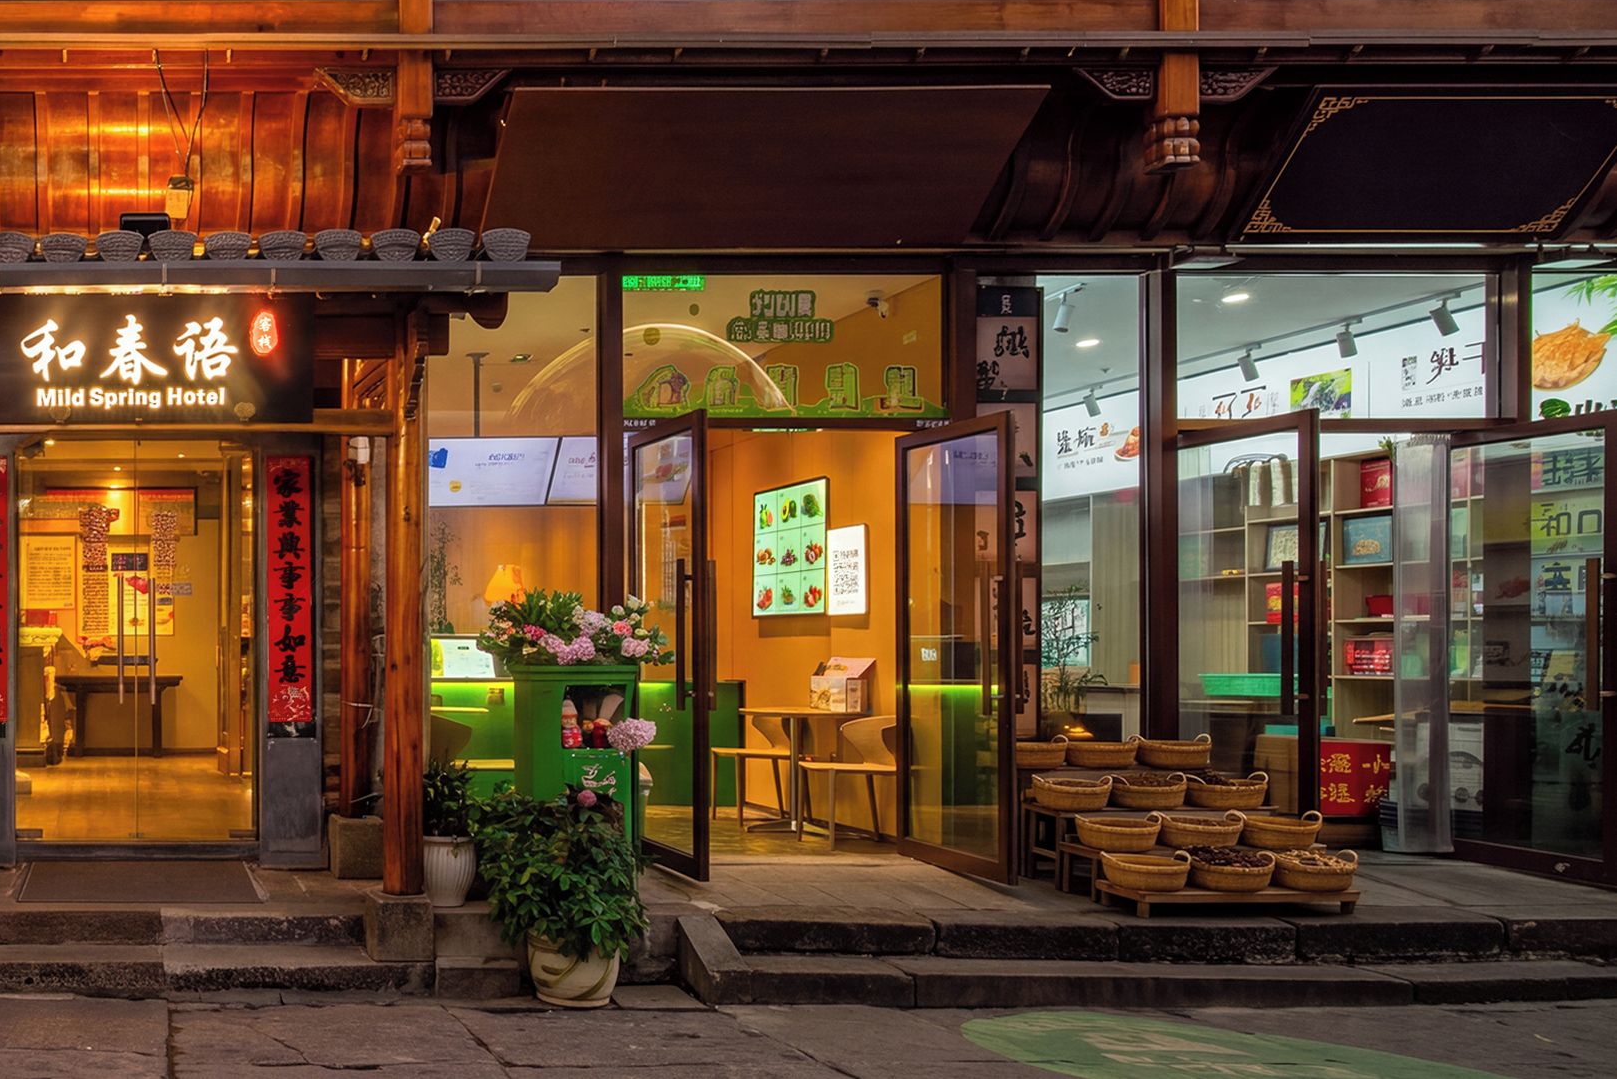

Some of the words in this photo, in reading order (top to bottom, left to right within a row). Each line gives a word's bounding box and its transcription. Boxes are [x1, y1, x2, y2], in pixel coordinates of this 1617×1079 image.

[20, 313, 239, 385] 和春语
[257, 317, 274, 350] 客栈
[36, 388, 85, 407] Mild
[89, 387, 162, 410] Spring
[166, 387, 226, 406] Hotel
